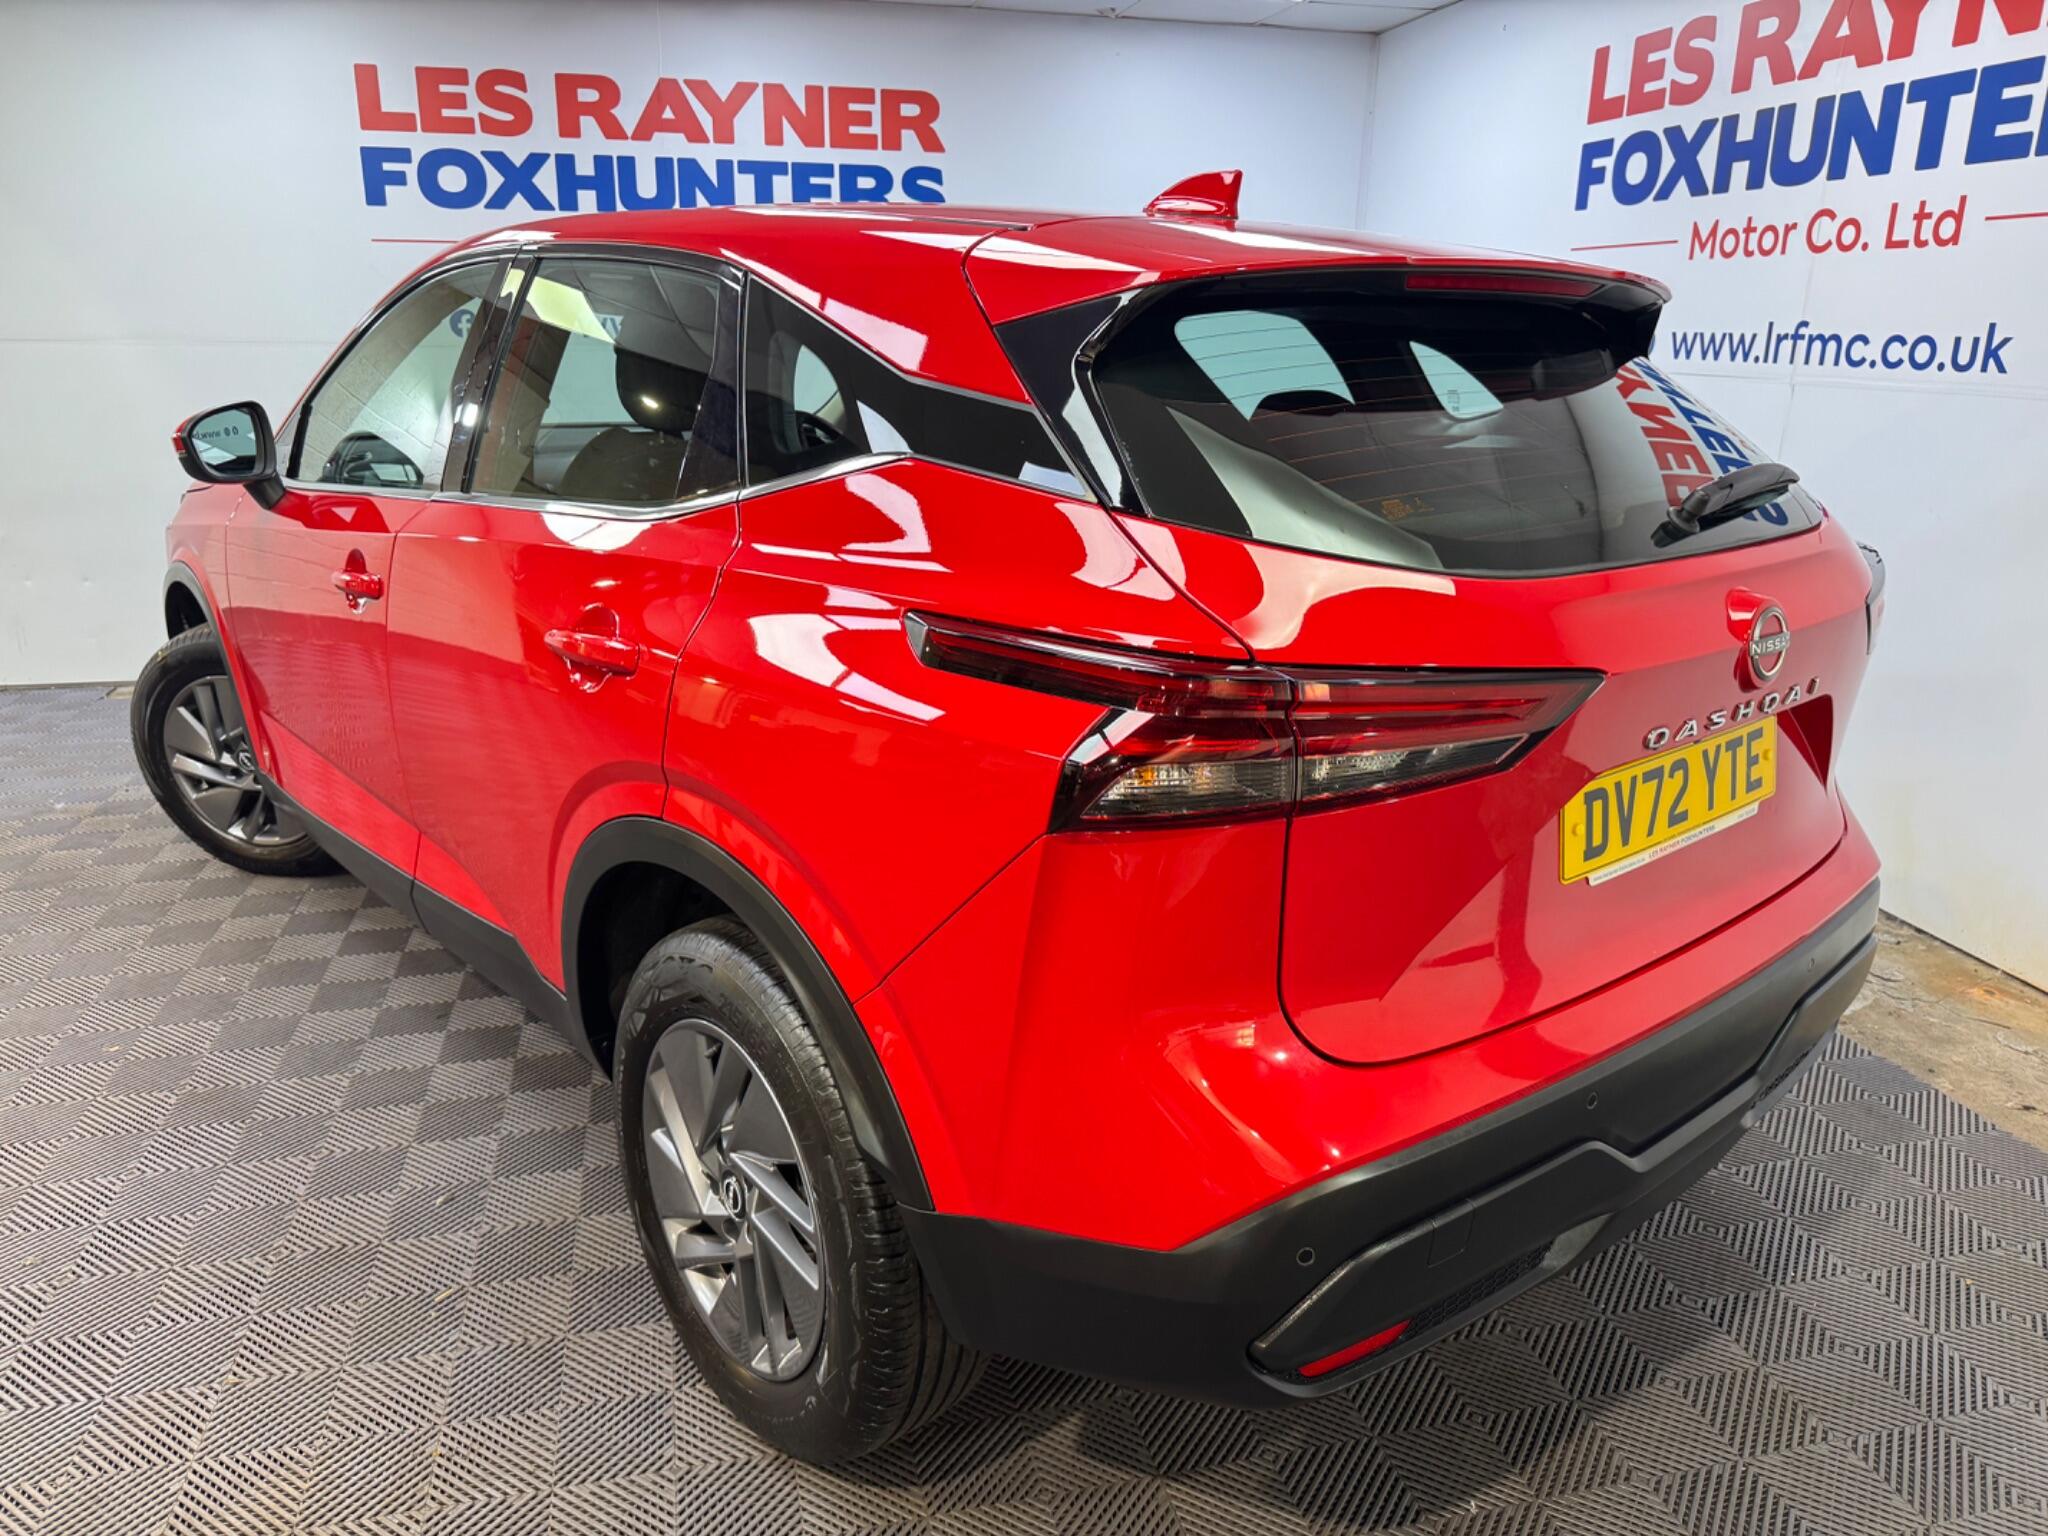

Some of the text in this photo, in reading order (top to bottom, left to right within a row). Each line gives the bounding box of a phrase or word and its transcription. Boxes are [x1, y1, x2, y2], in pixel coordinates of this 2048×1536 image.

[354, 63, 945, 153] LES RAYNER
[1587, 15, 1717, 125] LES
[1575, 56, 2048, 211] FOXHUNTE
[359, 146, 945, 212] FOXHUNTERS
[1689, 195, 1967, 260] Motor Co. Ltd
[1671, 321, 2013, 374] www.lrfmc.co.uk
[1583, 726, 1764, 863] DV72 YTE
